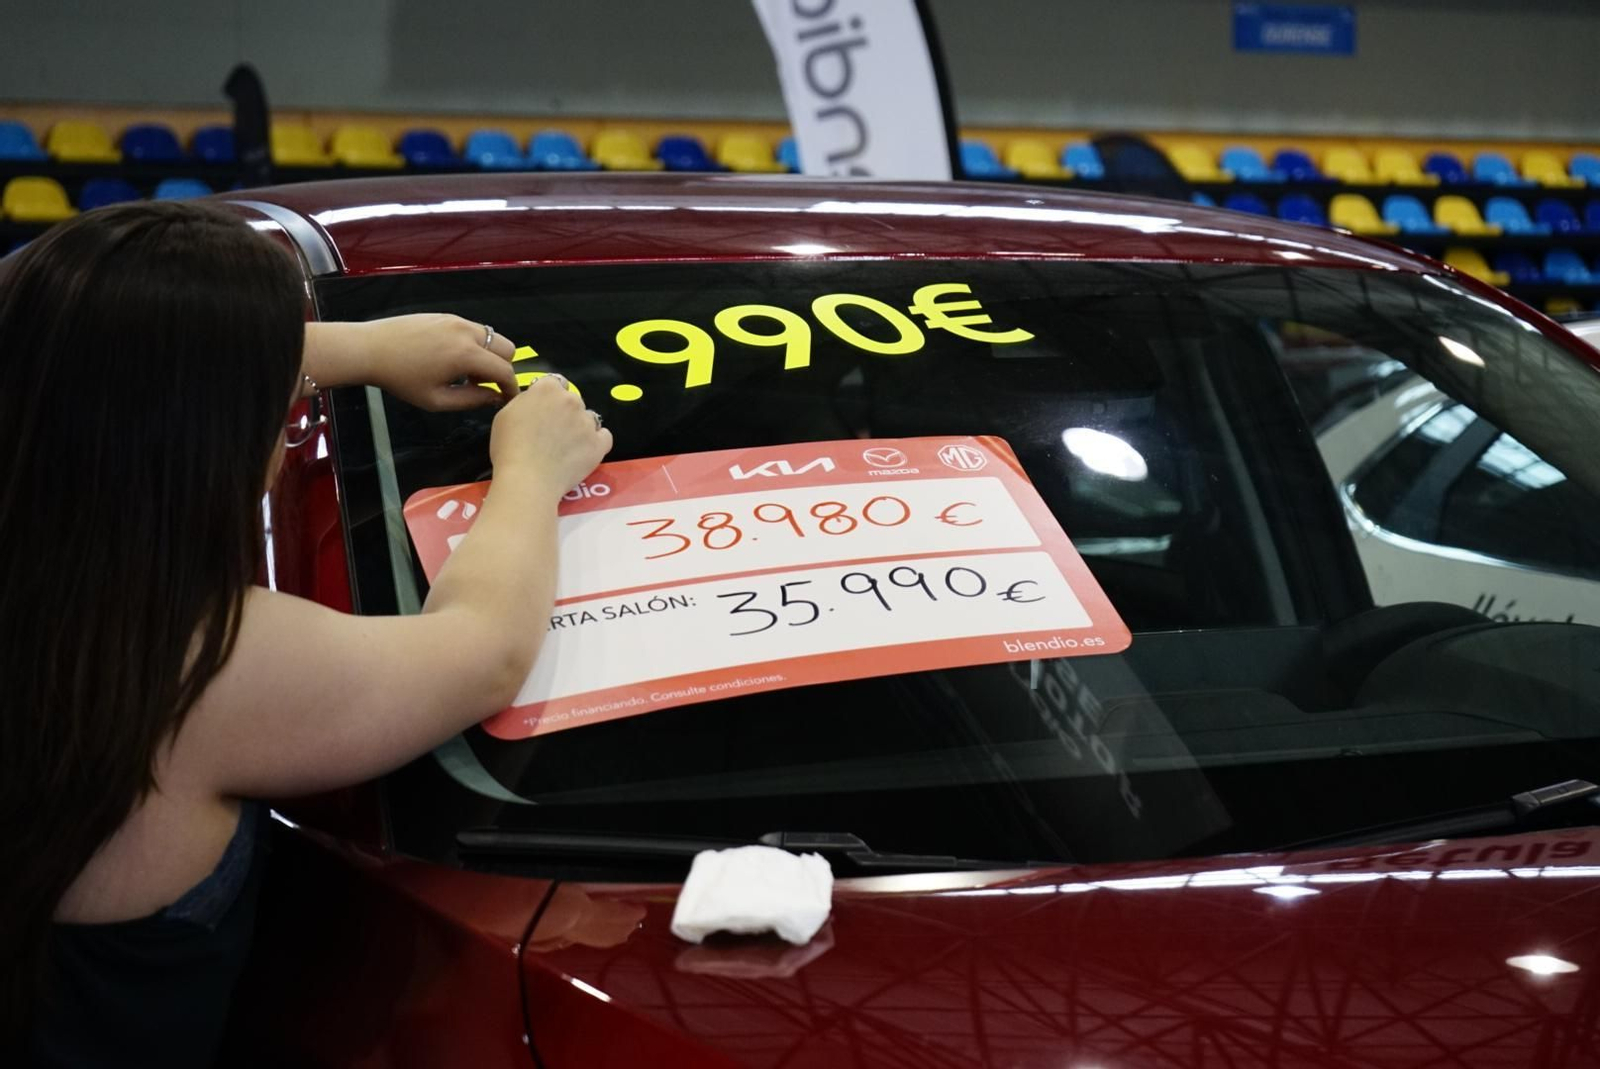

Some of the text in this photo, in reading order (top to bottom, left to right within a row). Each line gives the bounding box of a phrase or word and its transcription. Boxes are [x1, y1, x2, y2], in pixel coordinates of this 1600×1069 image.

[868, 467, 920, 476] mazda
[941, 446, 984, 469] MG
[626, 496, 911, 560] 38.980
[547, 611, 598, 631] RTA
[602, 595, 697, 620] SALÓN:
[1003, 634, 1105, 654] blendio.es
[572, 696, 649, 718] financiando.
[651, 685, 707, 702] Consulte
[709, 674, 787, 692] condiciones.
